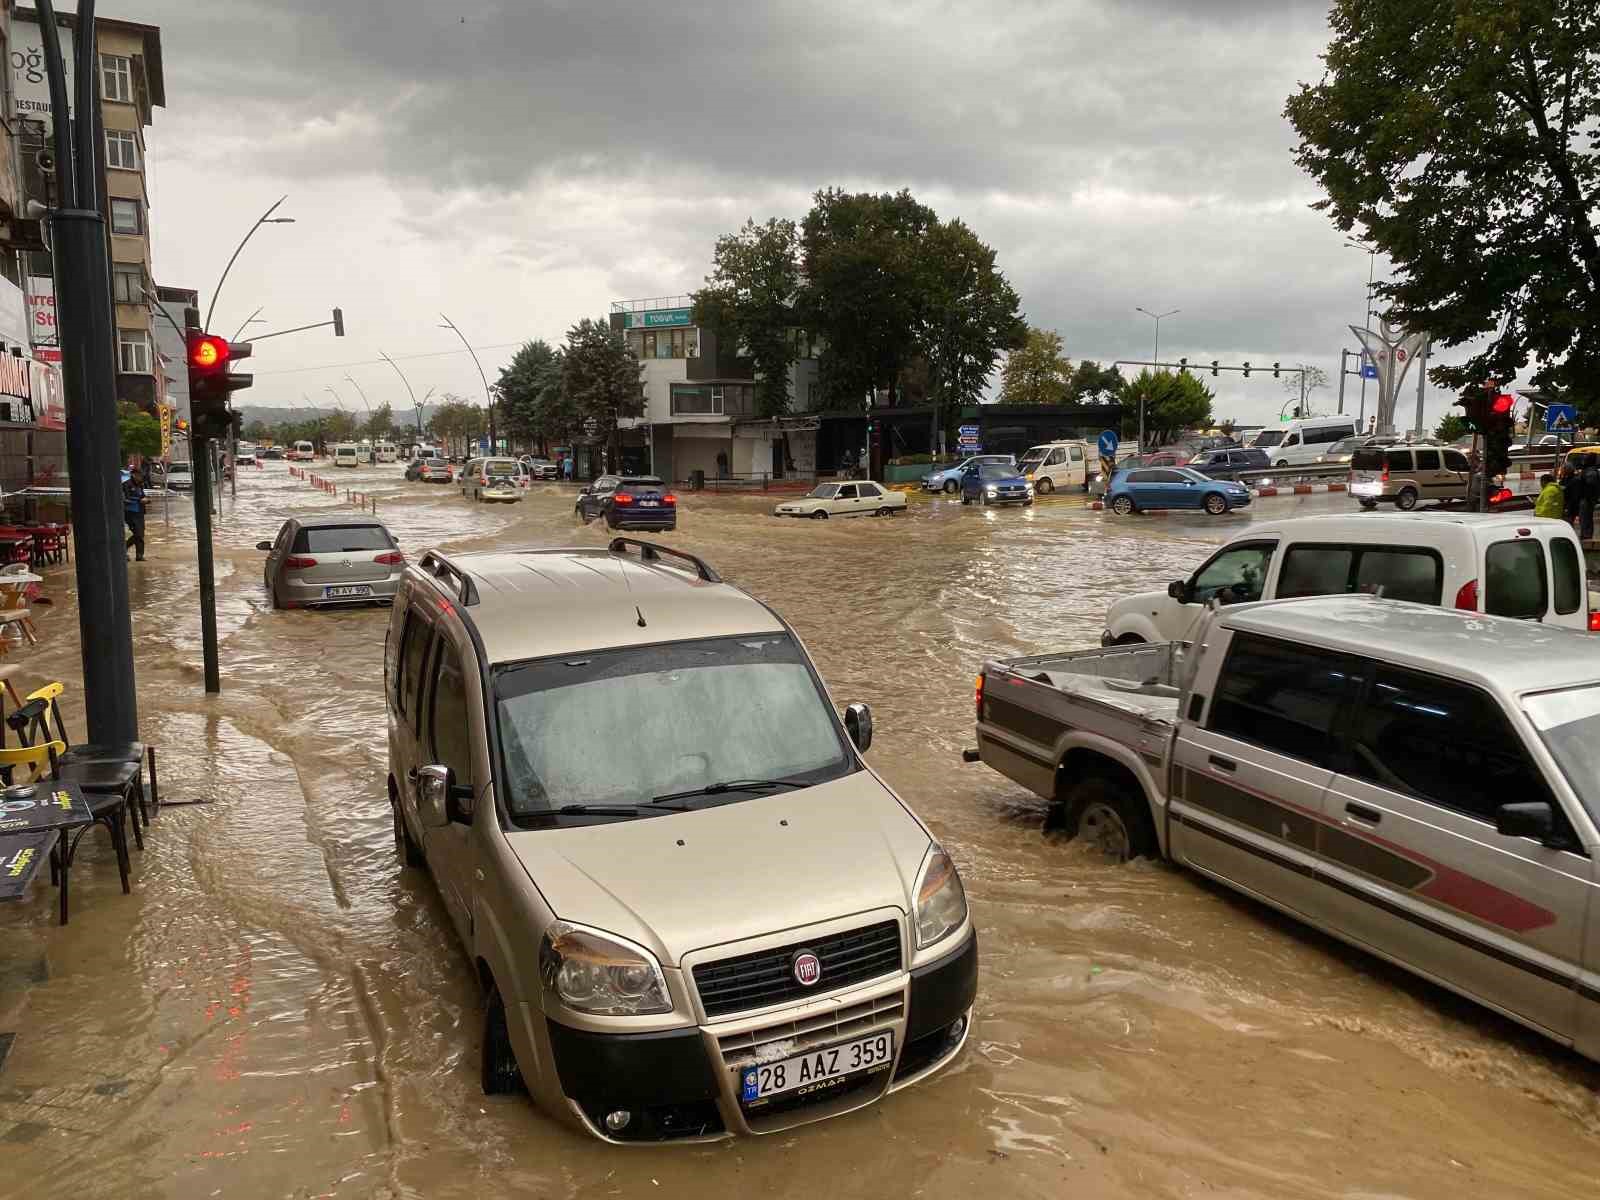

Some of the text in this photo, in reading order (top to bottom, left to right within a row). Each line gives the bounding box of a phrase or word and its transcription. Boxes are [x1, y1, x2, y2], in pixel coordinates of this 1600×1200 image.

[800, 962, 816, 979] FIAT
[760, 1064, 786, 1094] 28
[799, 1049, 840, 1083] AAZ
[850, 1037, 887, 1068] 359
